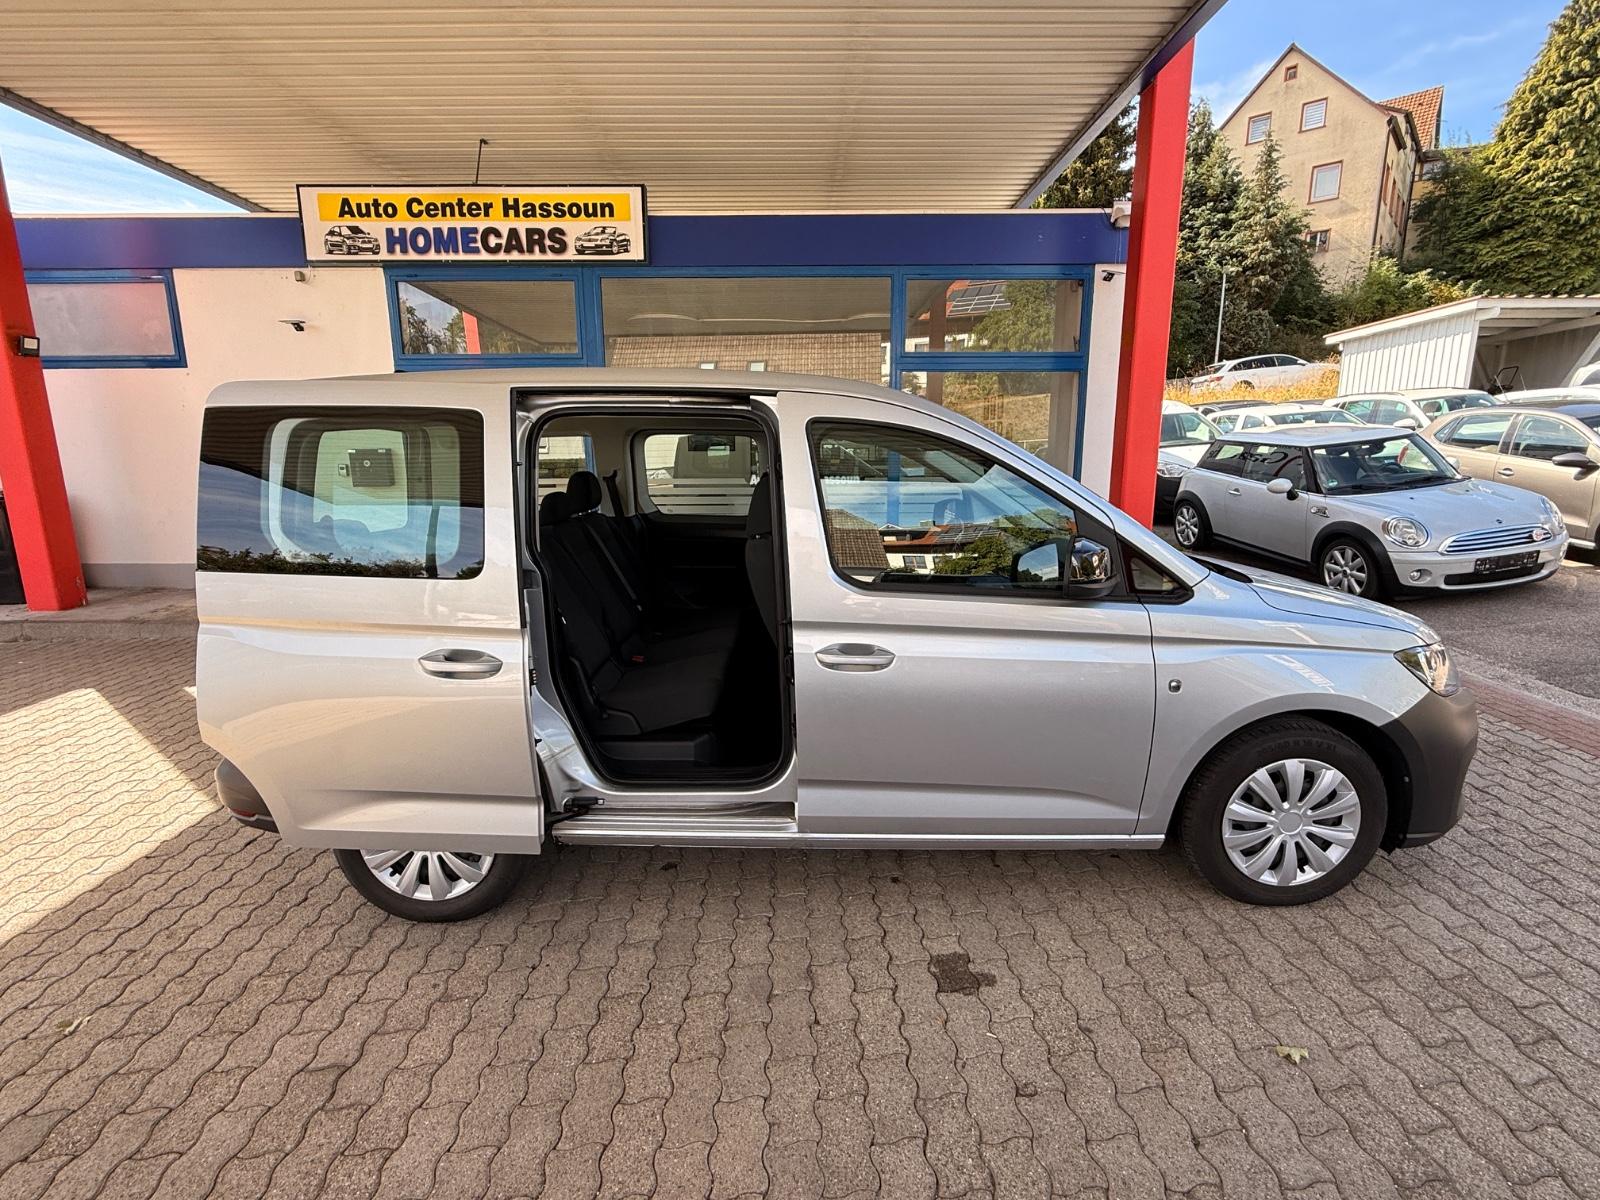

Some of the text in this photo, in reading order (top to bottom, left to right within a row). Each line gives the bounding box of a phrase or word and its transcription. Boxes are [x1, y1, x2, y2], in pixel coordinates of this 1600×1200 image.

[338, 198, 615, 218] Auto Center Hassoun
[386, 227, 567, 255] HOMECARS
